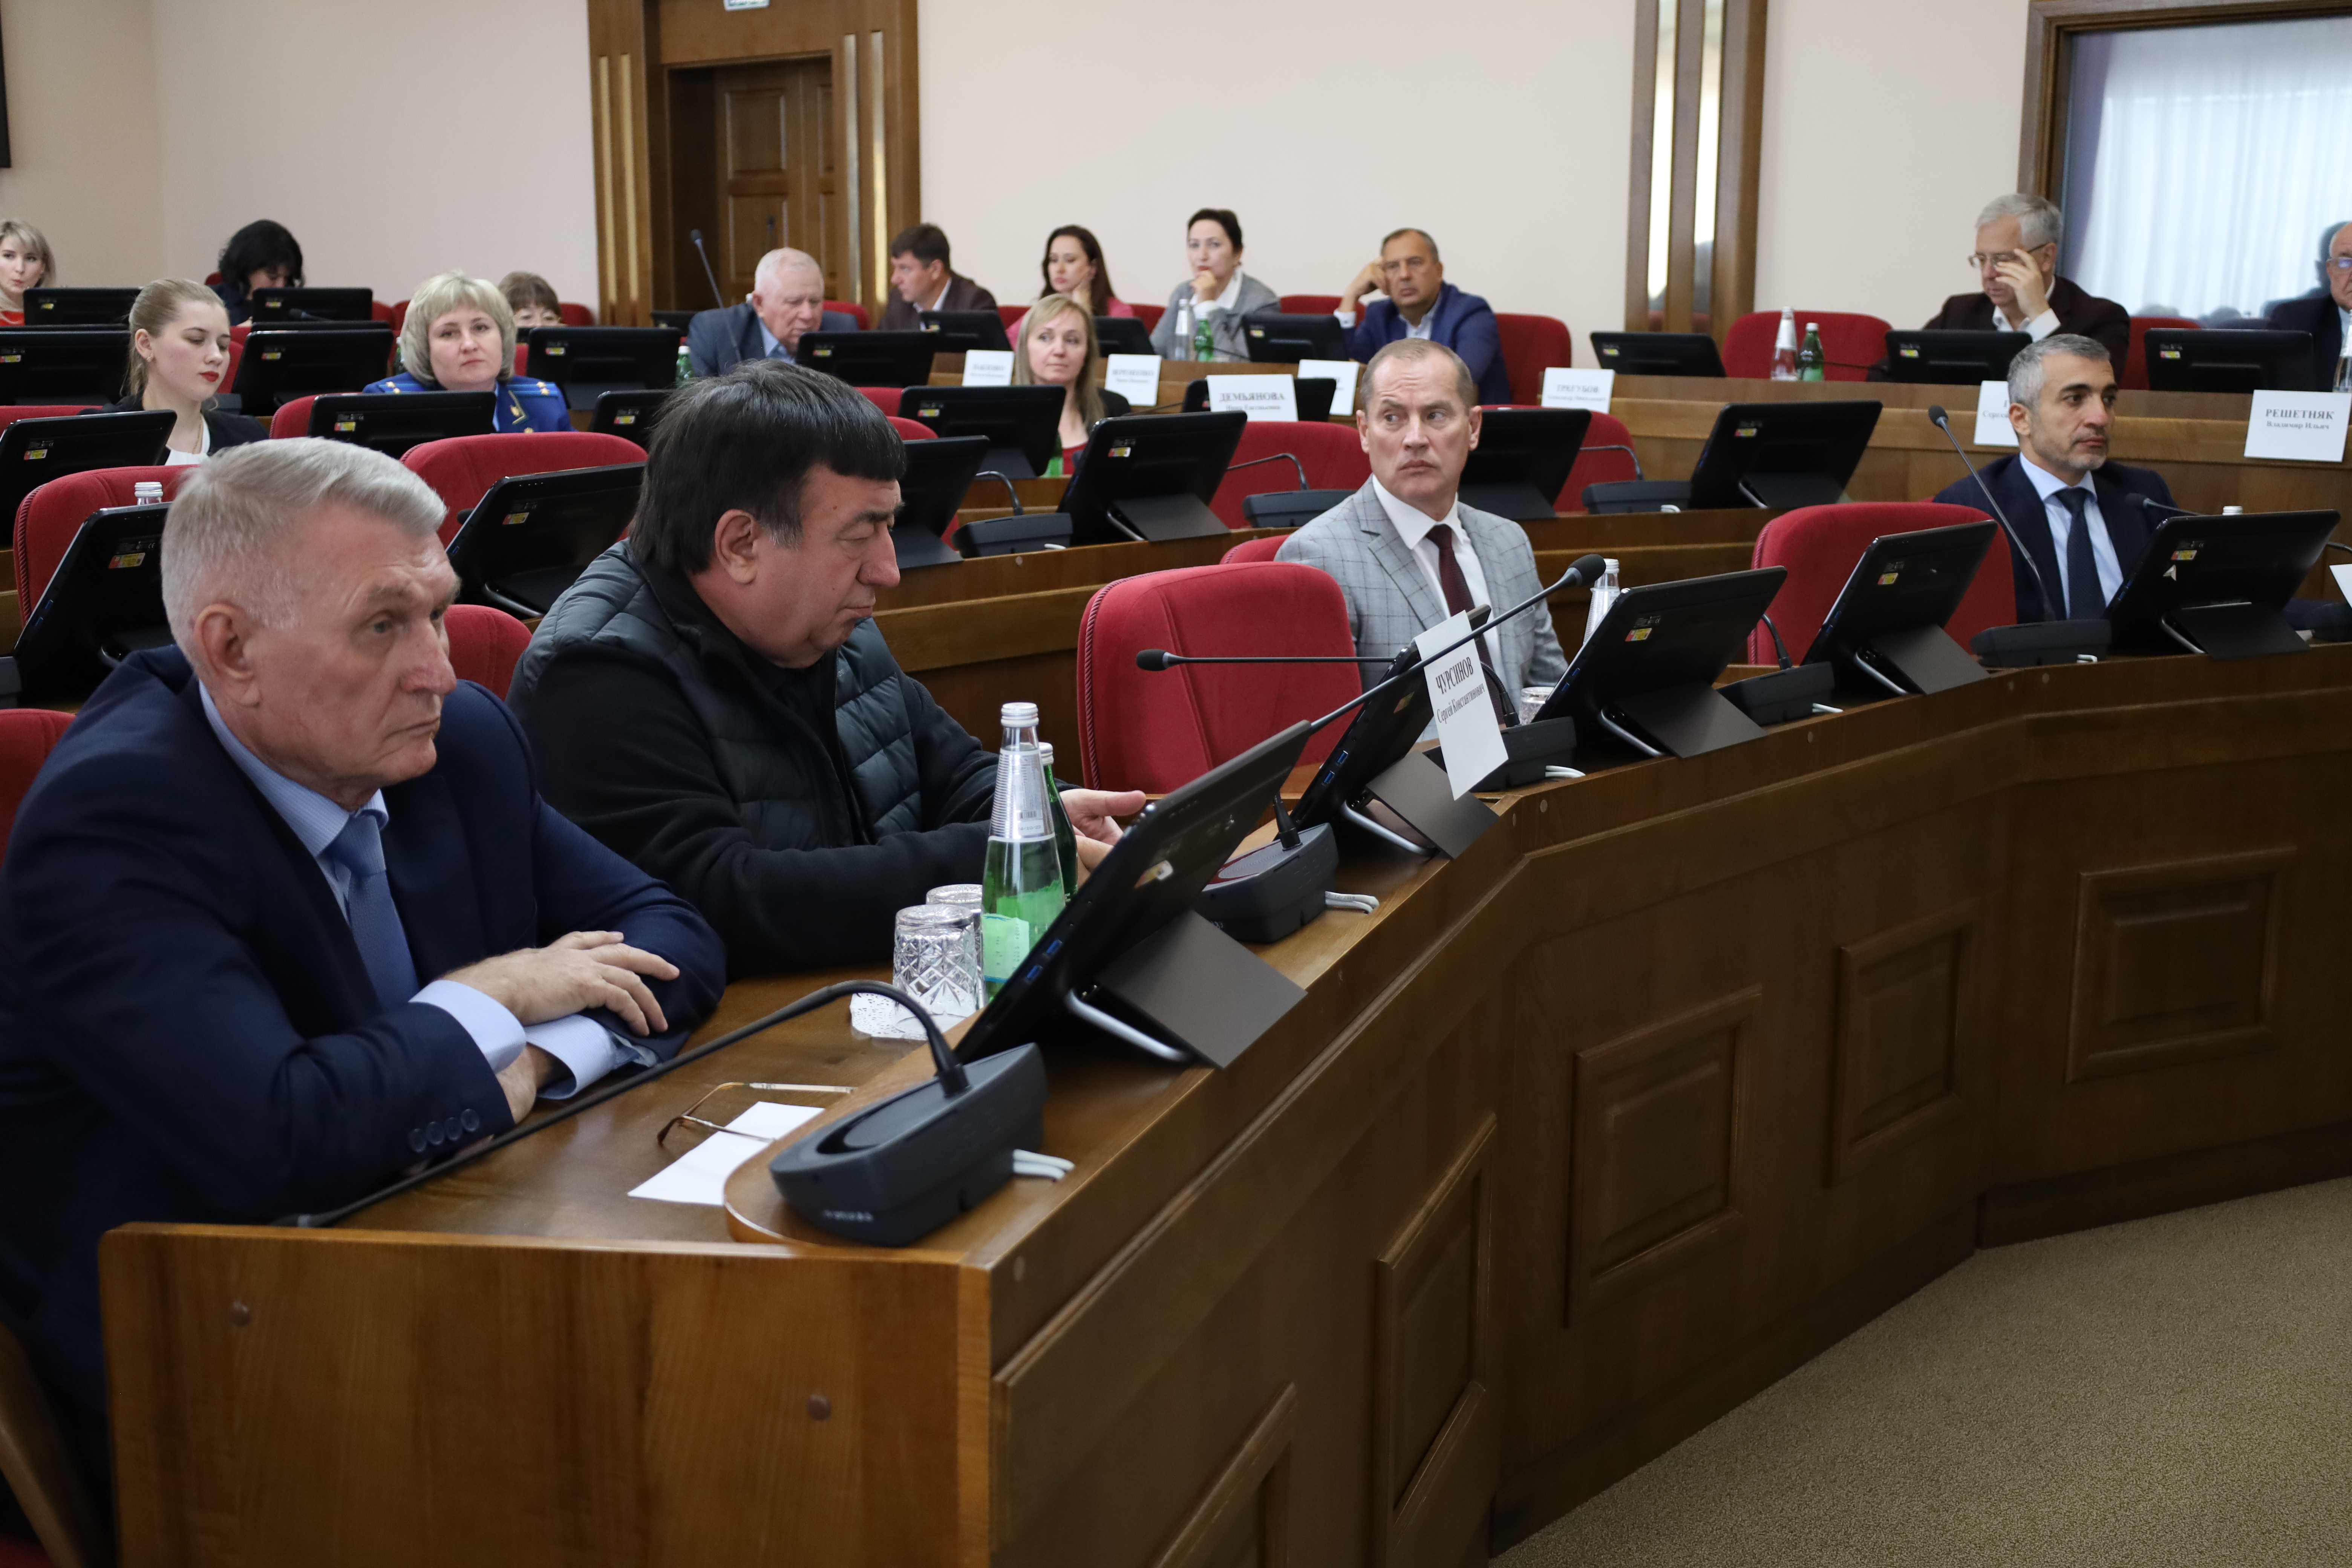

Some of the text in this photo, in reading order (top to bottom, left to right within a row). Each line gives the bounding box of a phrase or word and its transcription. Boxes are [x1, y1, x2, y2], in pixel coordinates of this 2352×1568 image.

[1219, 392, 1285, 402] ДЕМЬЯНОВА
[2266, 409, 2335, 420] РЕШЕТНЯК
[2266, 421, 2303, 429] Владимир
[1436, 657, 1474, 695] ЧУРСИНОВ
[1437, 683, 1485, 724] Сергей Константинович
